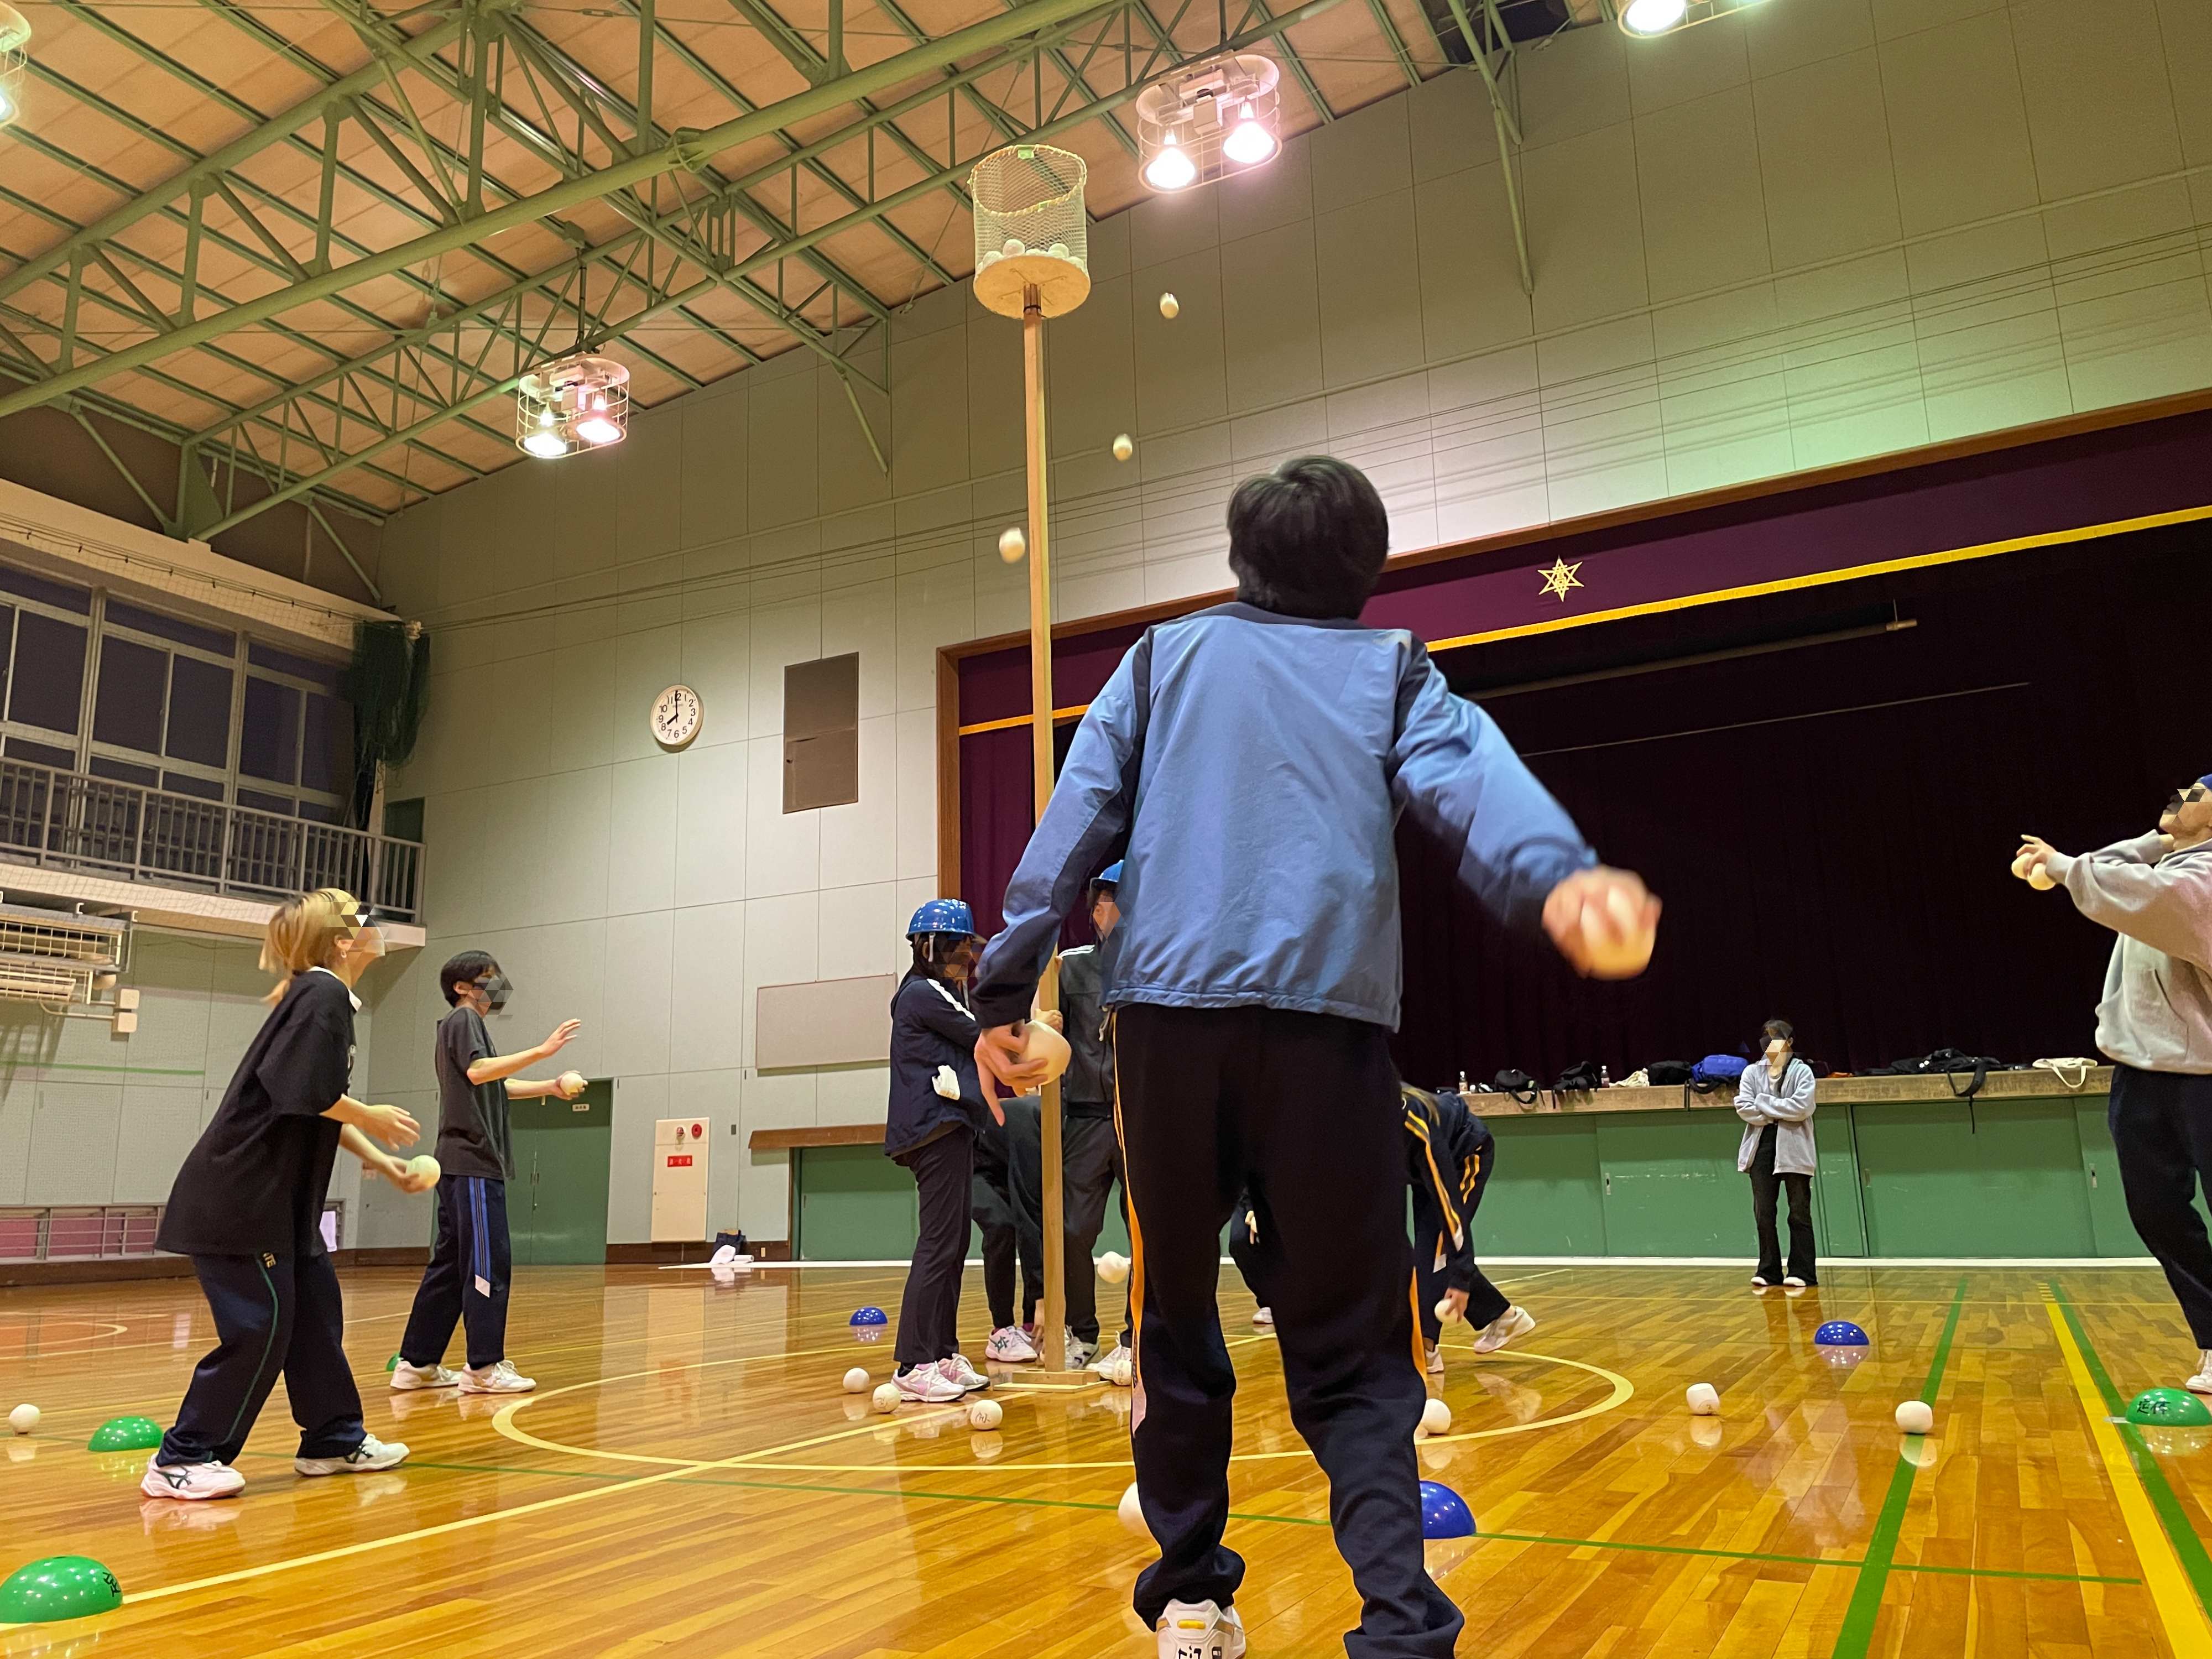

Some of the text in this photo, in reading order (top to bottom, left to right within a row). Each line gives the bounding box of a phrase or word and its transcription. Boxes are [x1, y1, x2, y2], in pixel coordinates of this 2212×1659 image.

[667, 695, 673, 705] 11
[688, 699, 693, 707] 2
[659, 705, 667, 713] 10
[690, 708, 696, 716] 3
[658, 714, 664, 723] 9
[661, 723, 666, 731] 8
[667, 729, 672, 737] 7
[674, 730, 679, 738] 6
